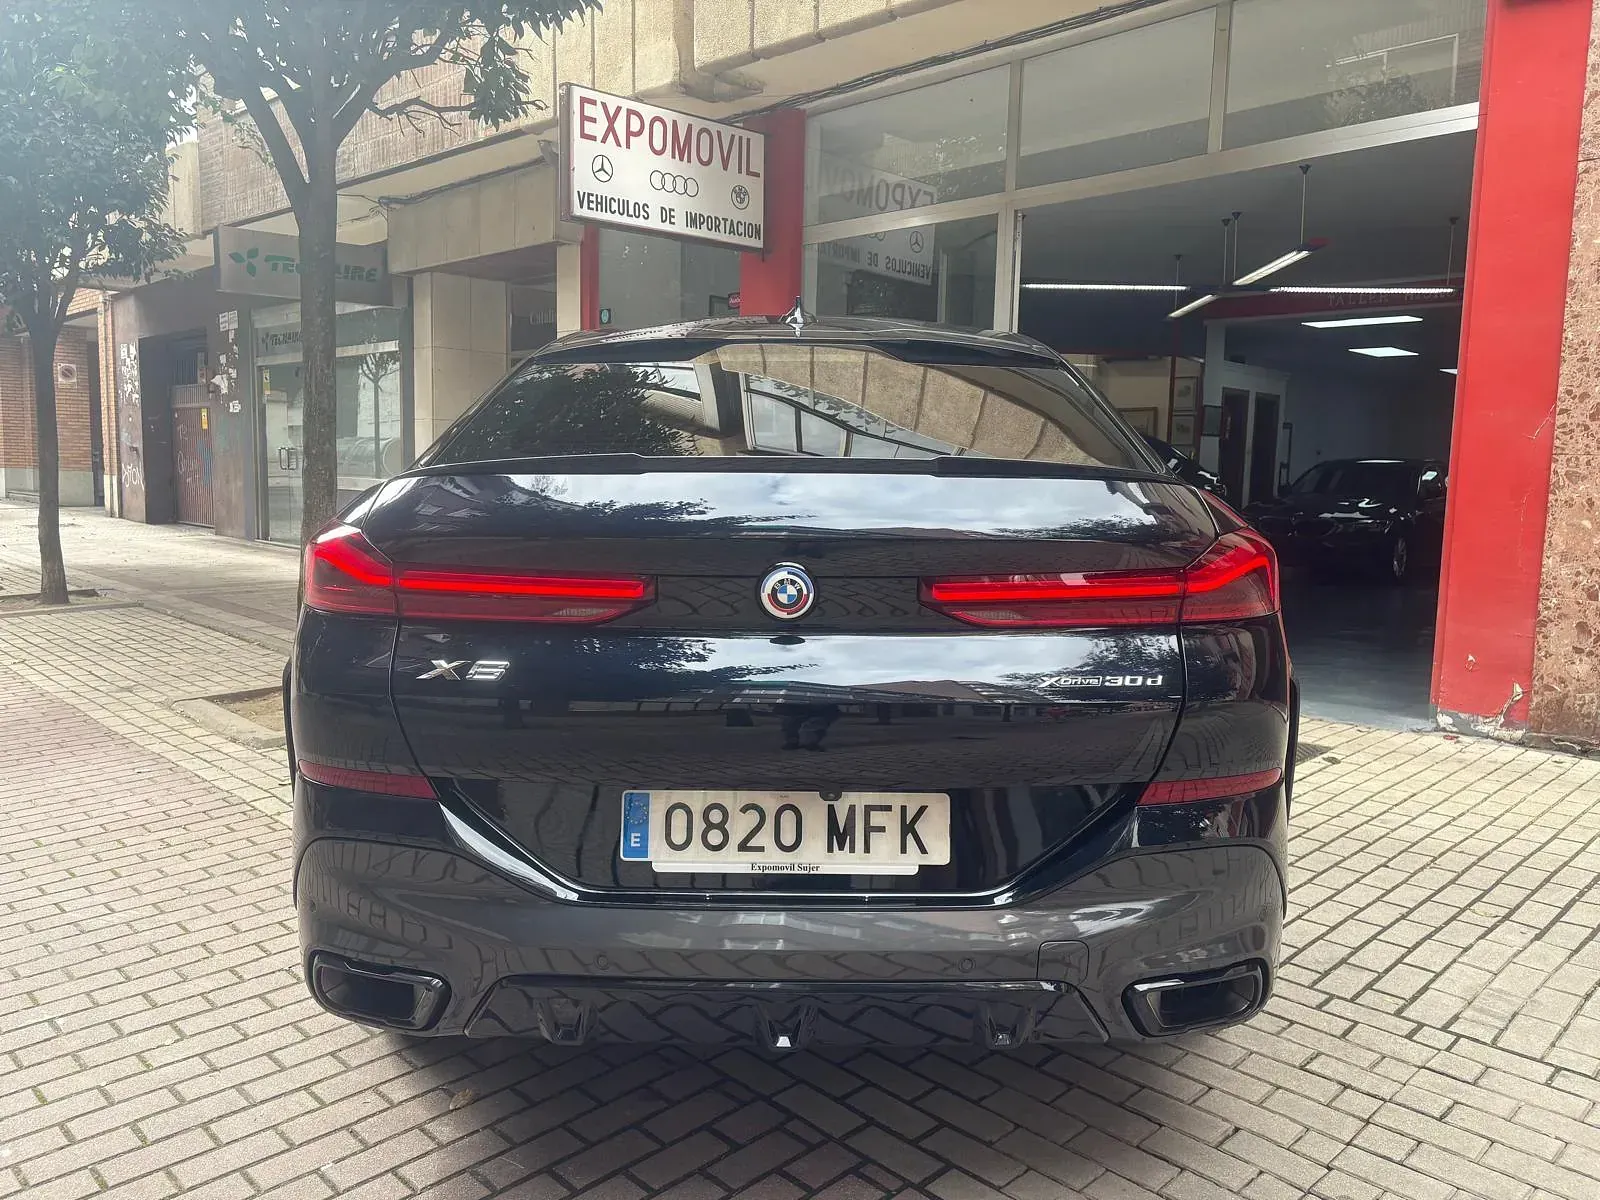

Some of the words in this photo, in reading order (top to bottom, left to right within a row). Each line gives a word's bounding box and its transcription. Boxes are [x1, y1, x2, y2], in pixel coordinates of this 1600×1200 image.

[580, 95, 760, 178] EXPOMOVIL
[577, 190, 650, 220] VEHICULOS
[660, 206, 676, 225] DE
[685, 211, 761, 240] IMPORTACION
[416, 659, 510, 681] X6
[630, 832, 641, 847] E
[664, 801, 803, 853] 0820
[827, 804, 929, 855] MFK
[751, 863, 795, 873] Expomovil
[797, 863, 821, 873] Sujer
